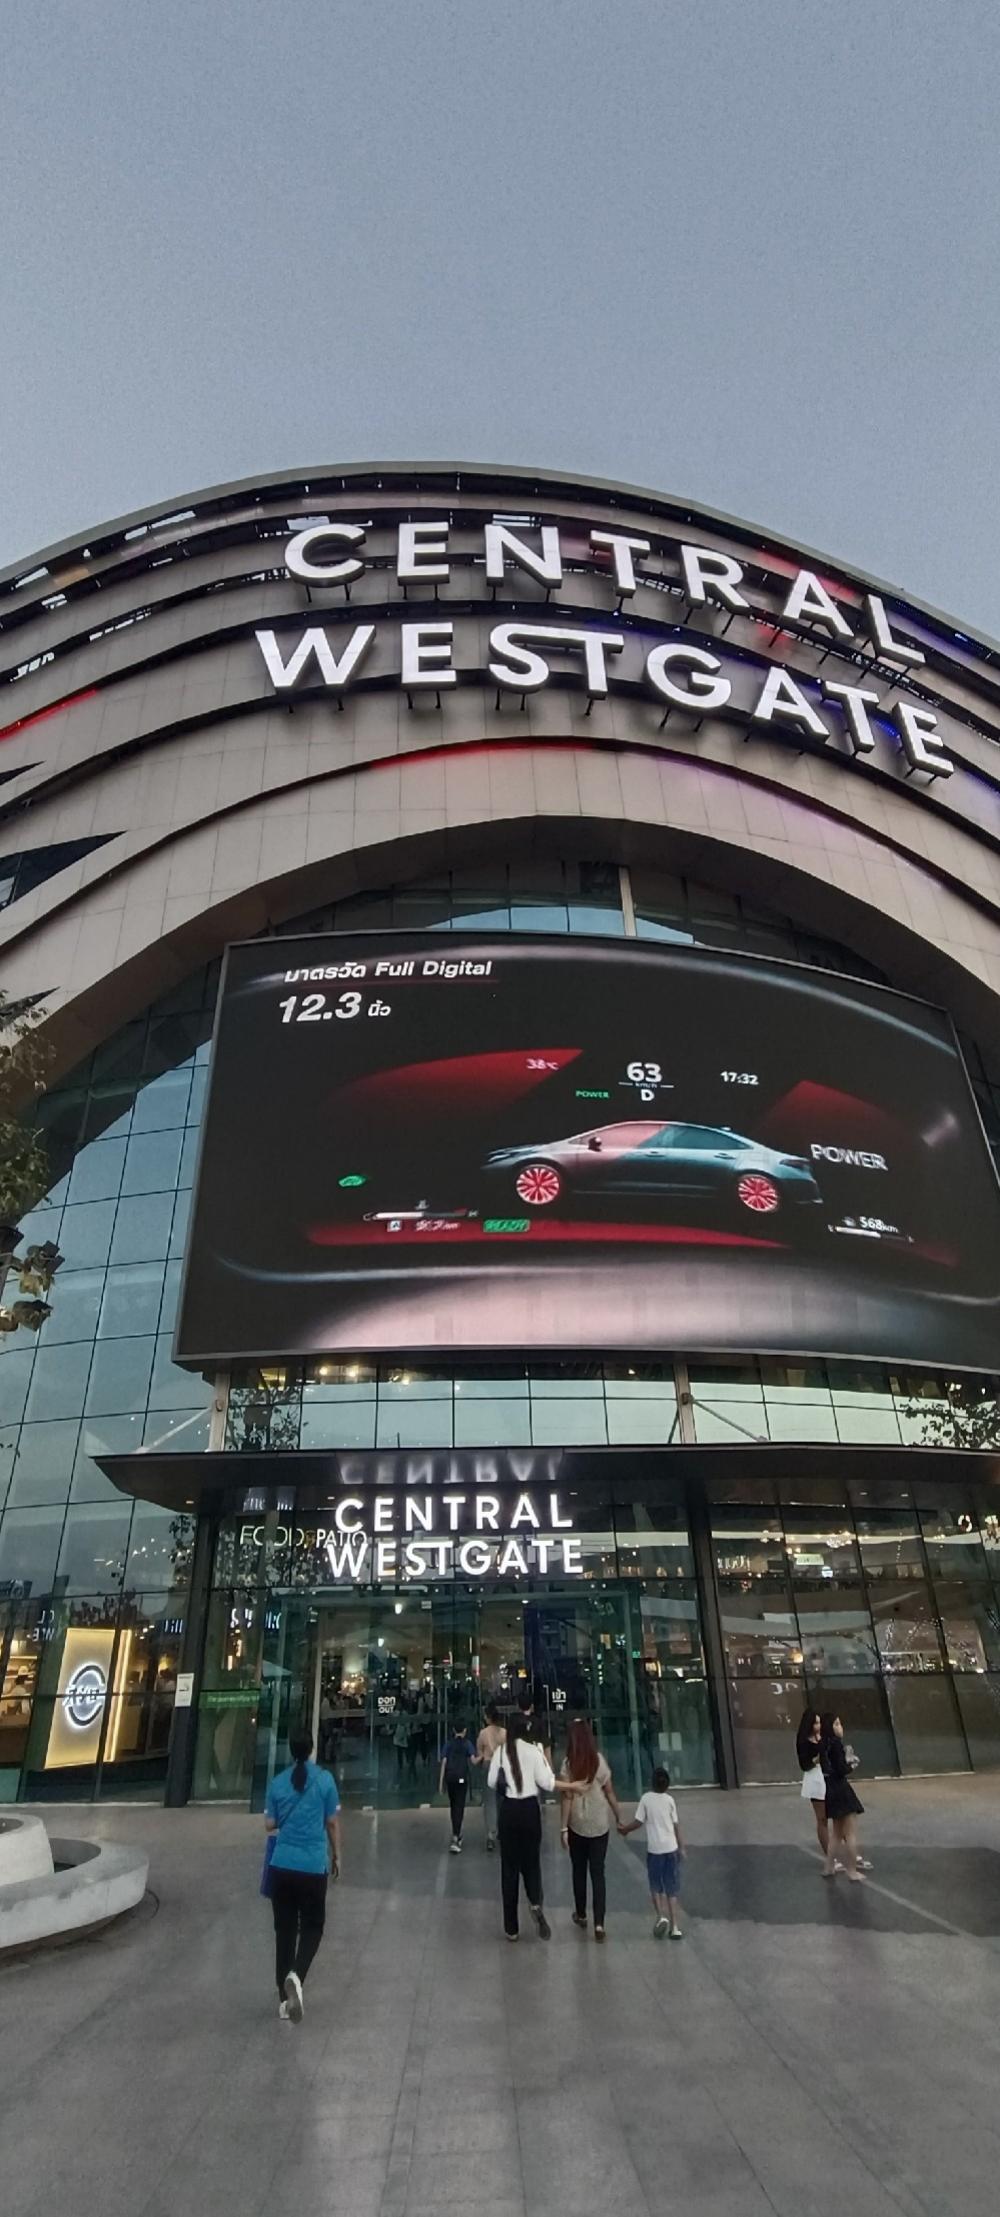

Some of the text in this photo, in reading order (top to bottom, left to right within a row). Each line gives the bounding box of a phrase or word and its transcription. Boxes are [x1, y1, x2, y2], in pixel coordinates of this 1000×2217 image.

[284, 521, 926, 670] CENTRAL
[255, 620, 956, 779] WESTGATE
[284, 960, 493, 983] มาตรวัด Full Digital
[278, 991, 363, 1024] 12.3
[626, 1061, 663, 1083] 63
[720, 1070, 759, 1086] 17:32
[575, 1089, 610, 1099] POWER
[640, 1088, 655, 1101] D
[810, 1143, 889, 1172] POWER
[335, 1493, 573, 1533] CENTRAL
[326, 1538, 584, 1578] WESTGATE
[378, 1706, 394, 1714] OUT
